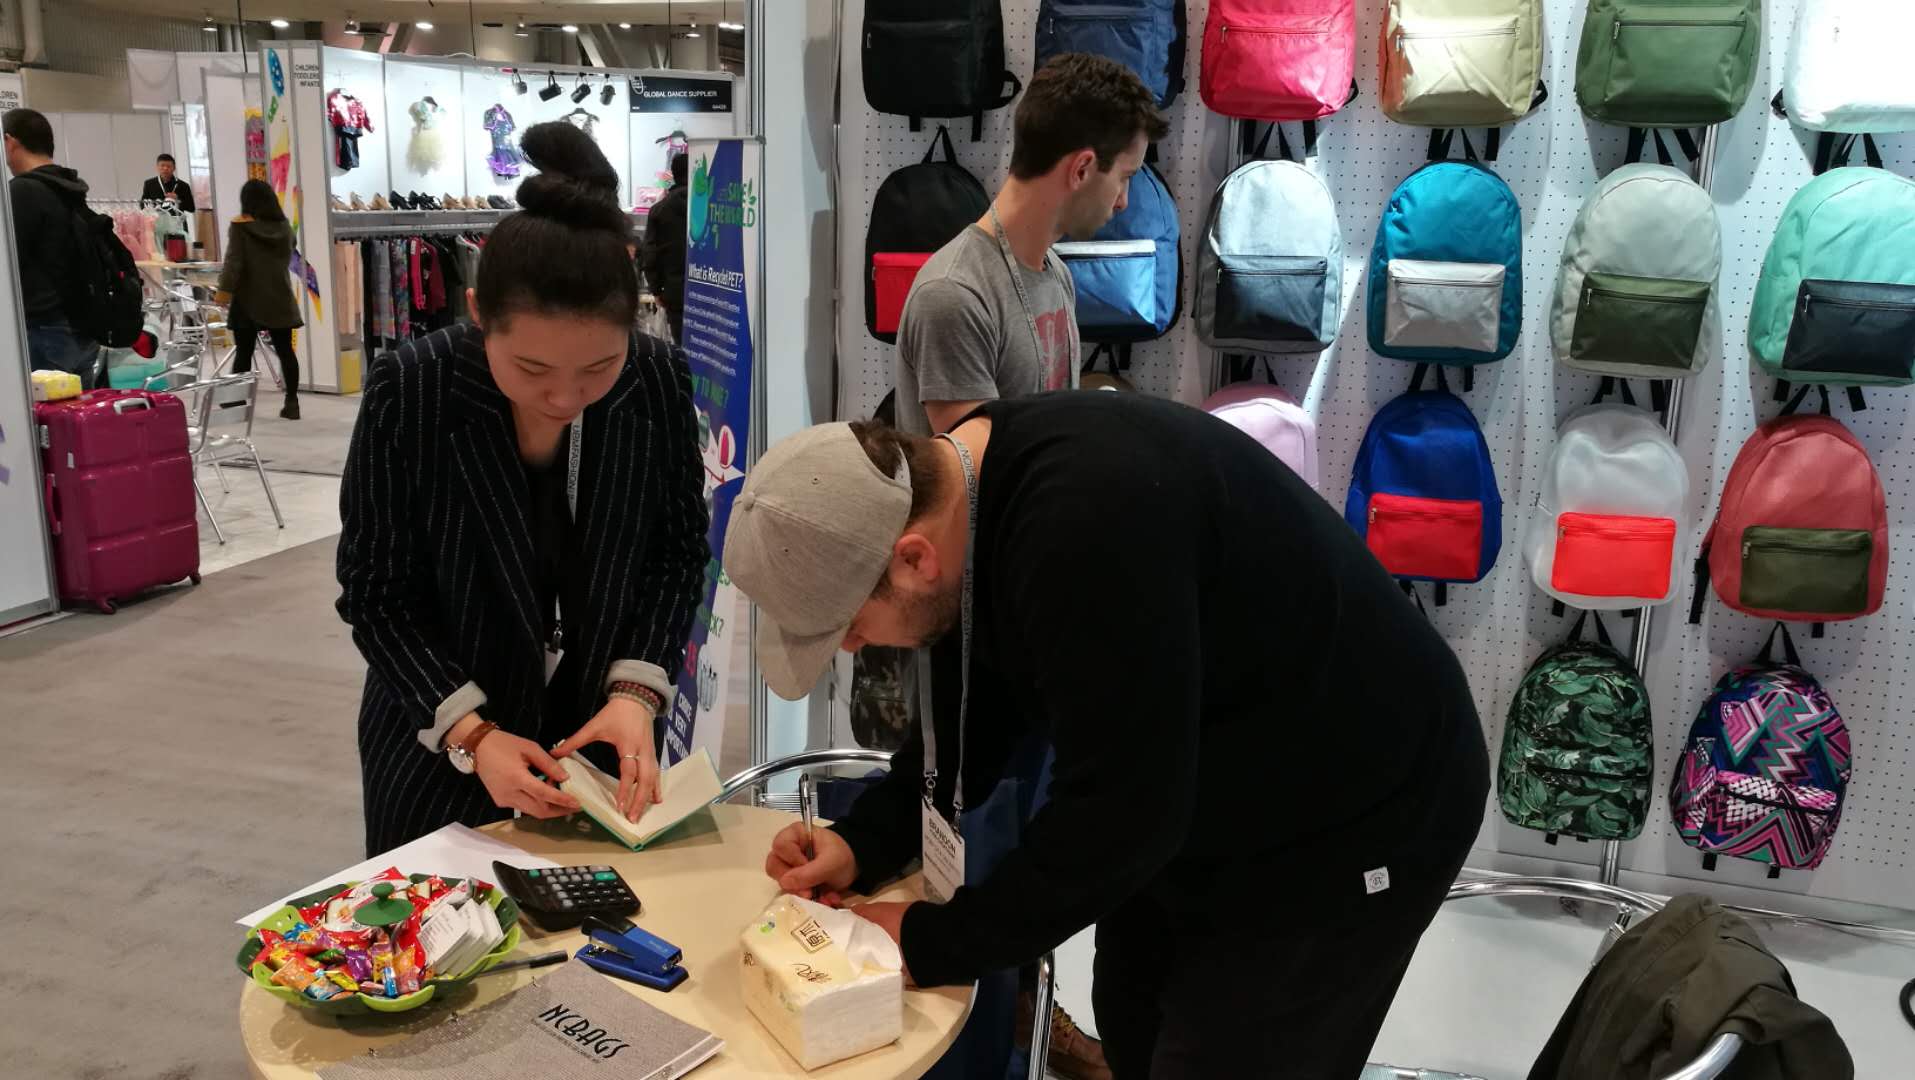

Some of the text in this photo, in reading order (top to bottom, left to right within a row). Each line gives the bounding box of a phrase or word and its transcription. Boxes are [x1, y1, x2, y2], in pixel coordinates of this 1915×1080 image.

[643, 90, 666, 98] GLOBAL
[688, 262, 703, 280] What
[538, 1003, 631, 1059] NCBAGS
